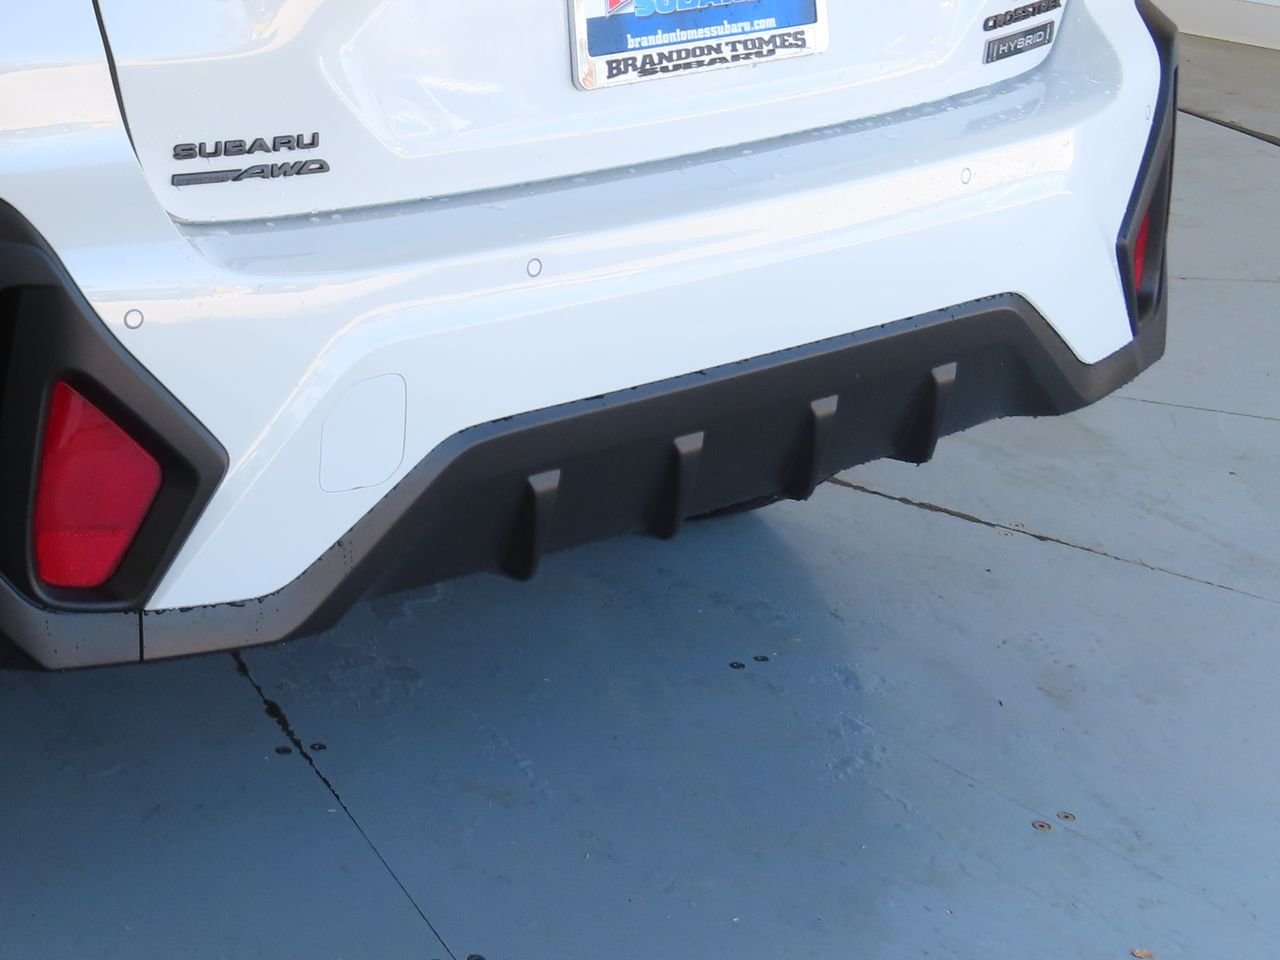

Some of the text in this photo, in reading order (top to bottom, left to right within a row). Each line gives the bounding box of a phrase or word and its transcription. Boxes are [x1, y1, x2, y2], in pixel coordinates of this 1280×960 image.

[627, 18, 777, 49] brandontomessubaru.com
[999, 31, 1045, 55] HYBRID
[606, 30, 807, 79] BRANDON TOMES
[637, 48, 776, 77] SUBARU
[173, 132, 320, 160] SUBARU
[231, 159, 330, 181] AWD
